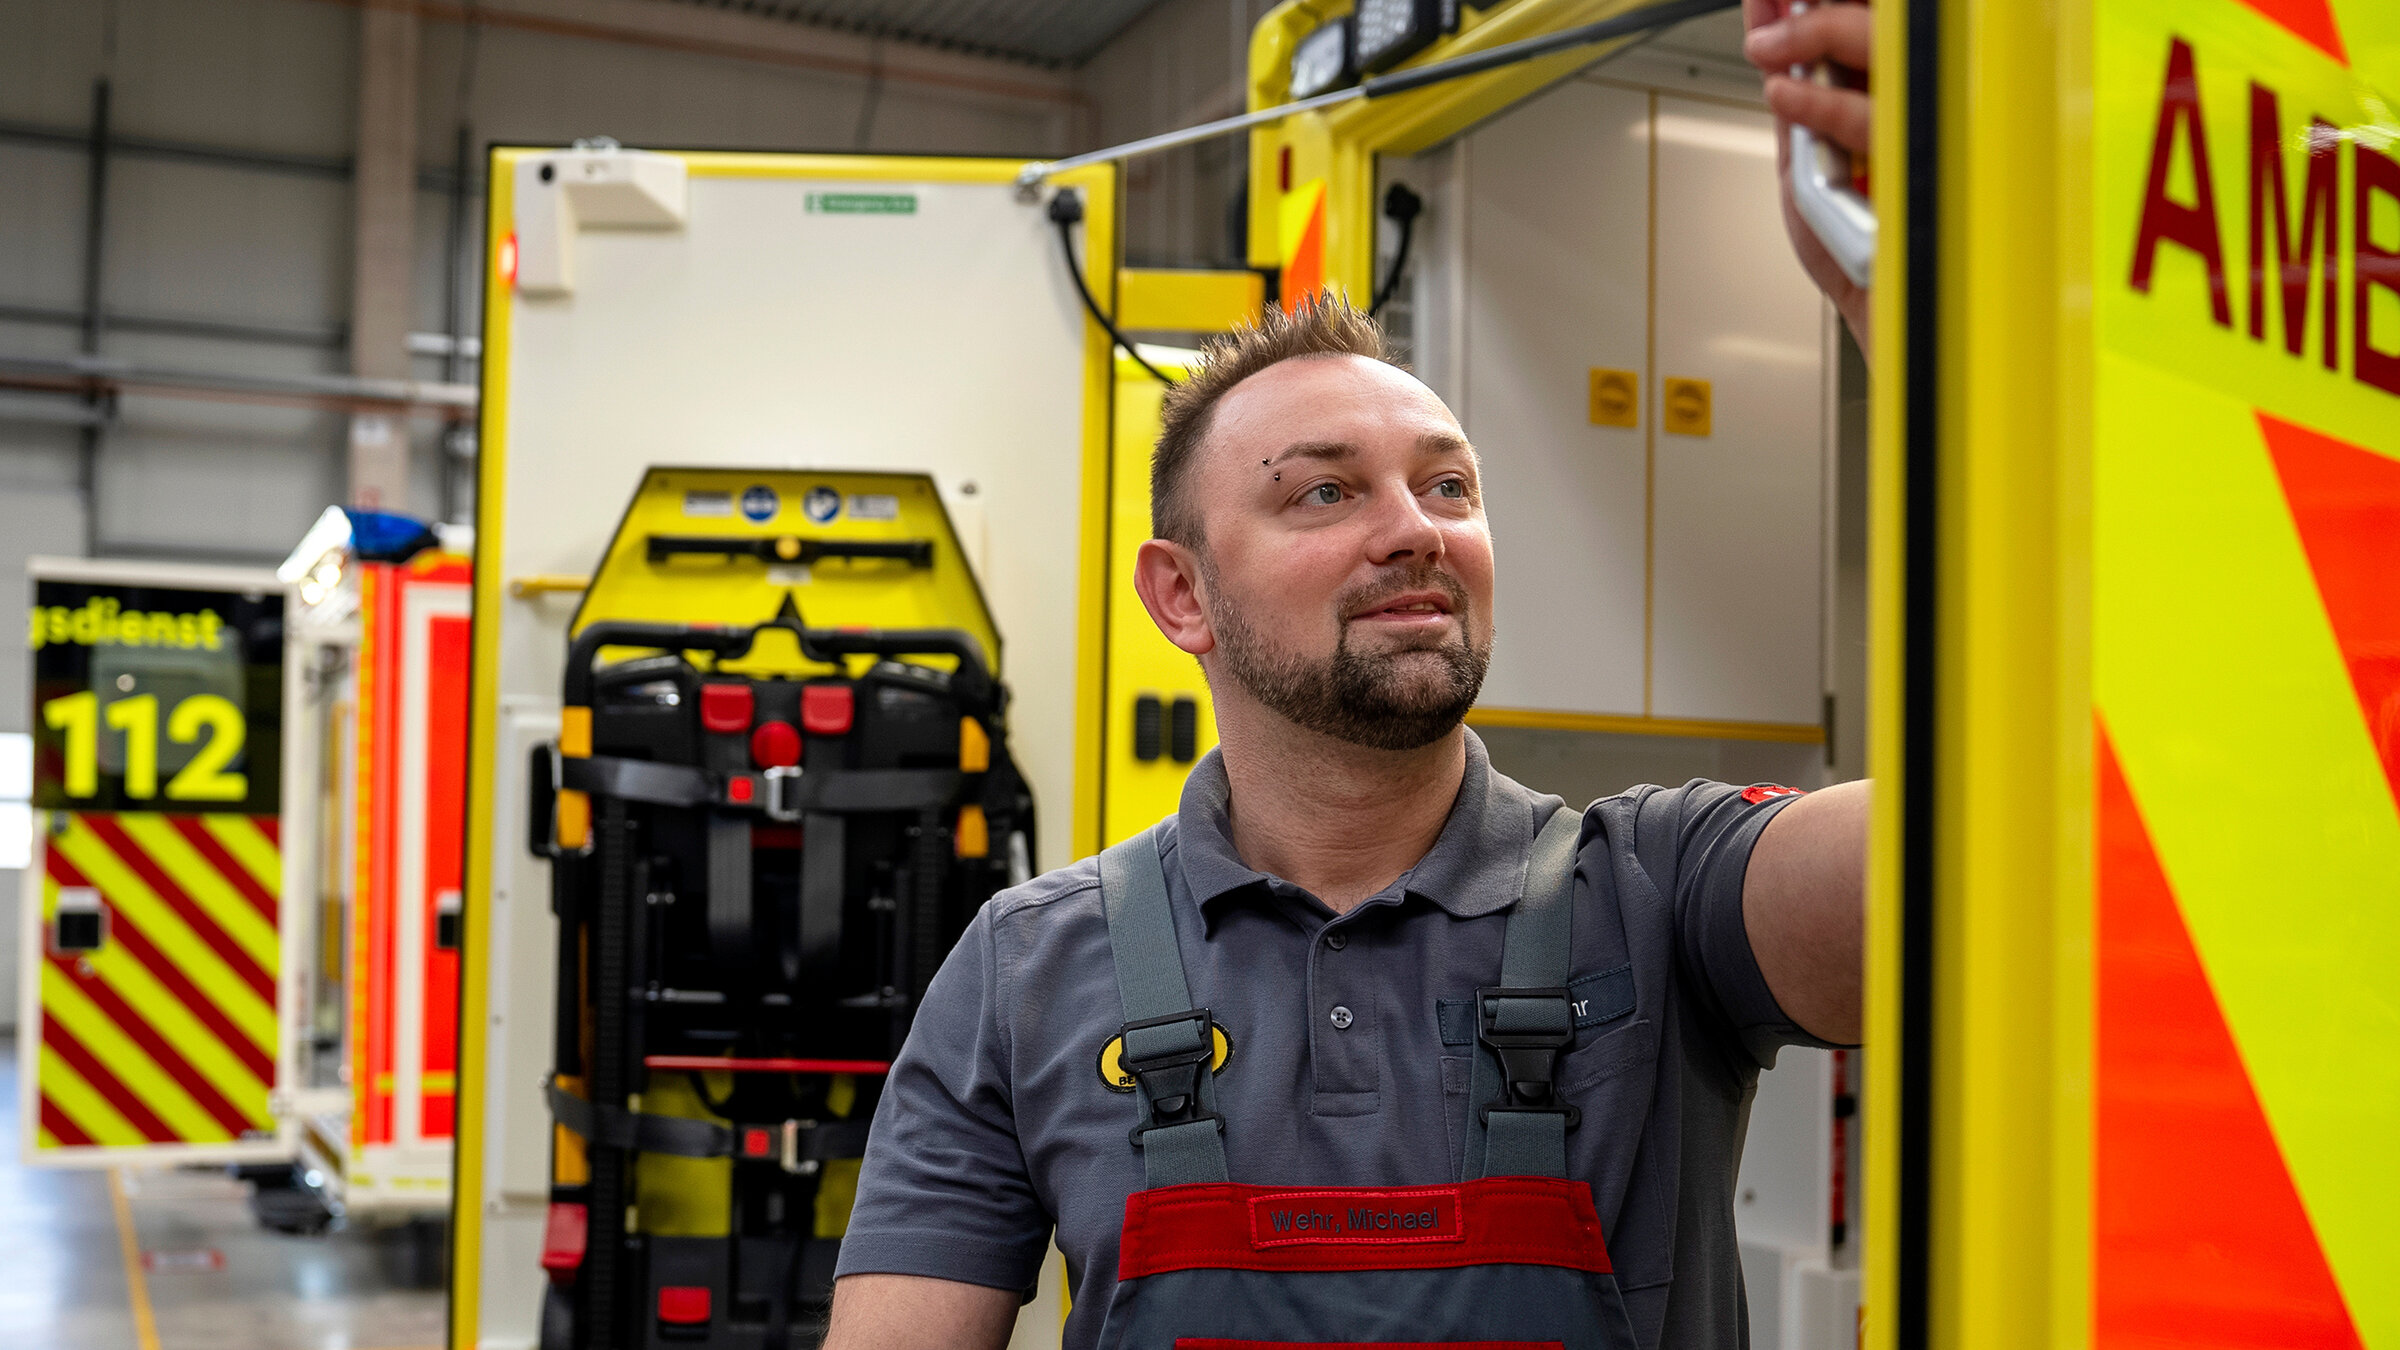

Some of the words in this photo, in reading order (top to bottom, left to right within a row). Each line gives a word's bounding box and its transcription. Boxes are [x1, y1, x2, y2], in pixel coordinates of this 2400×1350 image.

[43, 690, 248, 801] 112
[1270, 1208, 1341, 1233] Wehr,
[1348, 1207, 1438, 1231] Michael
